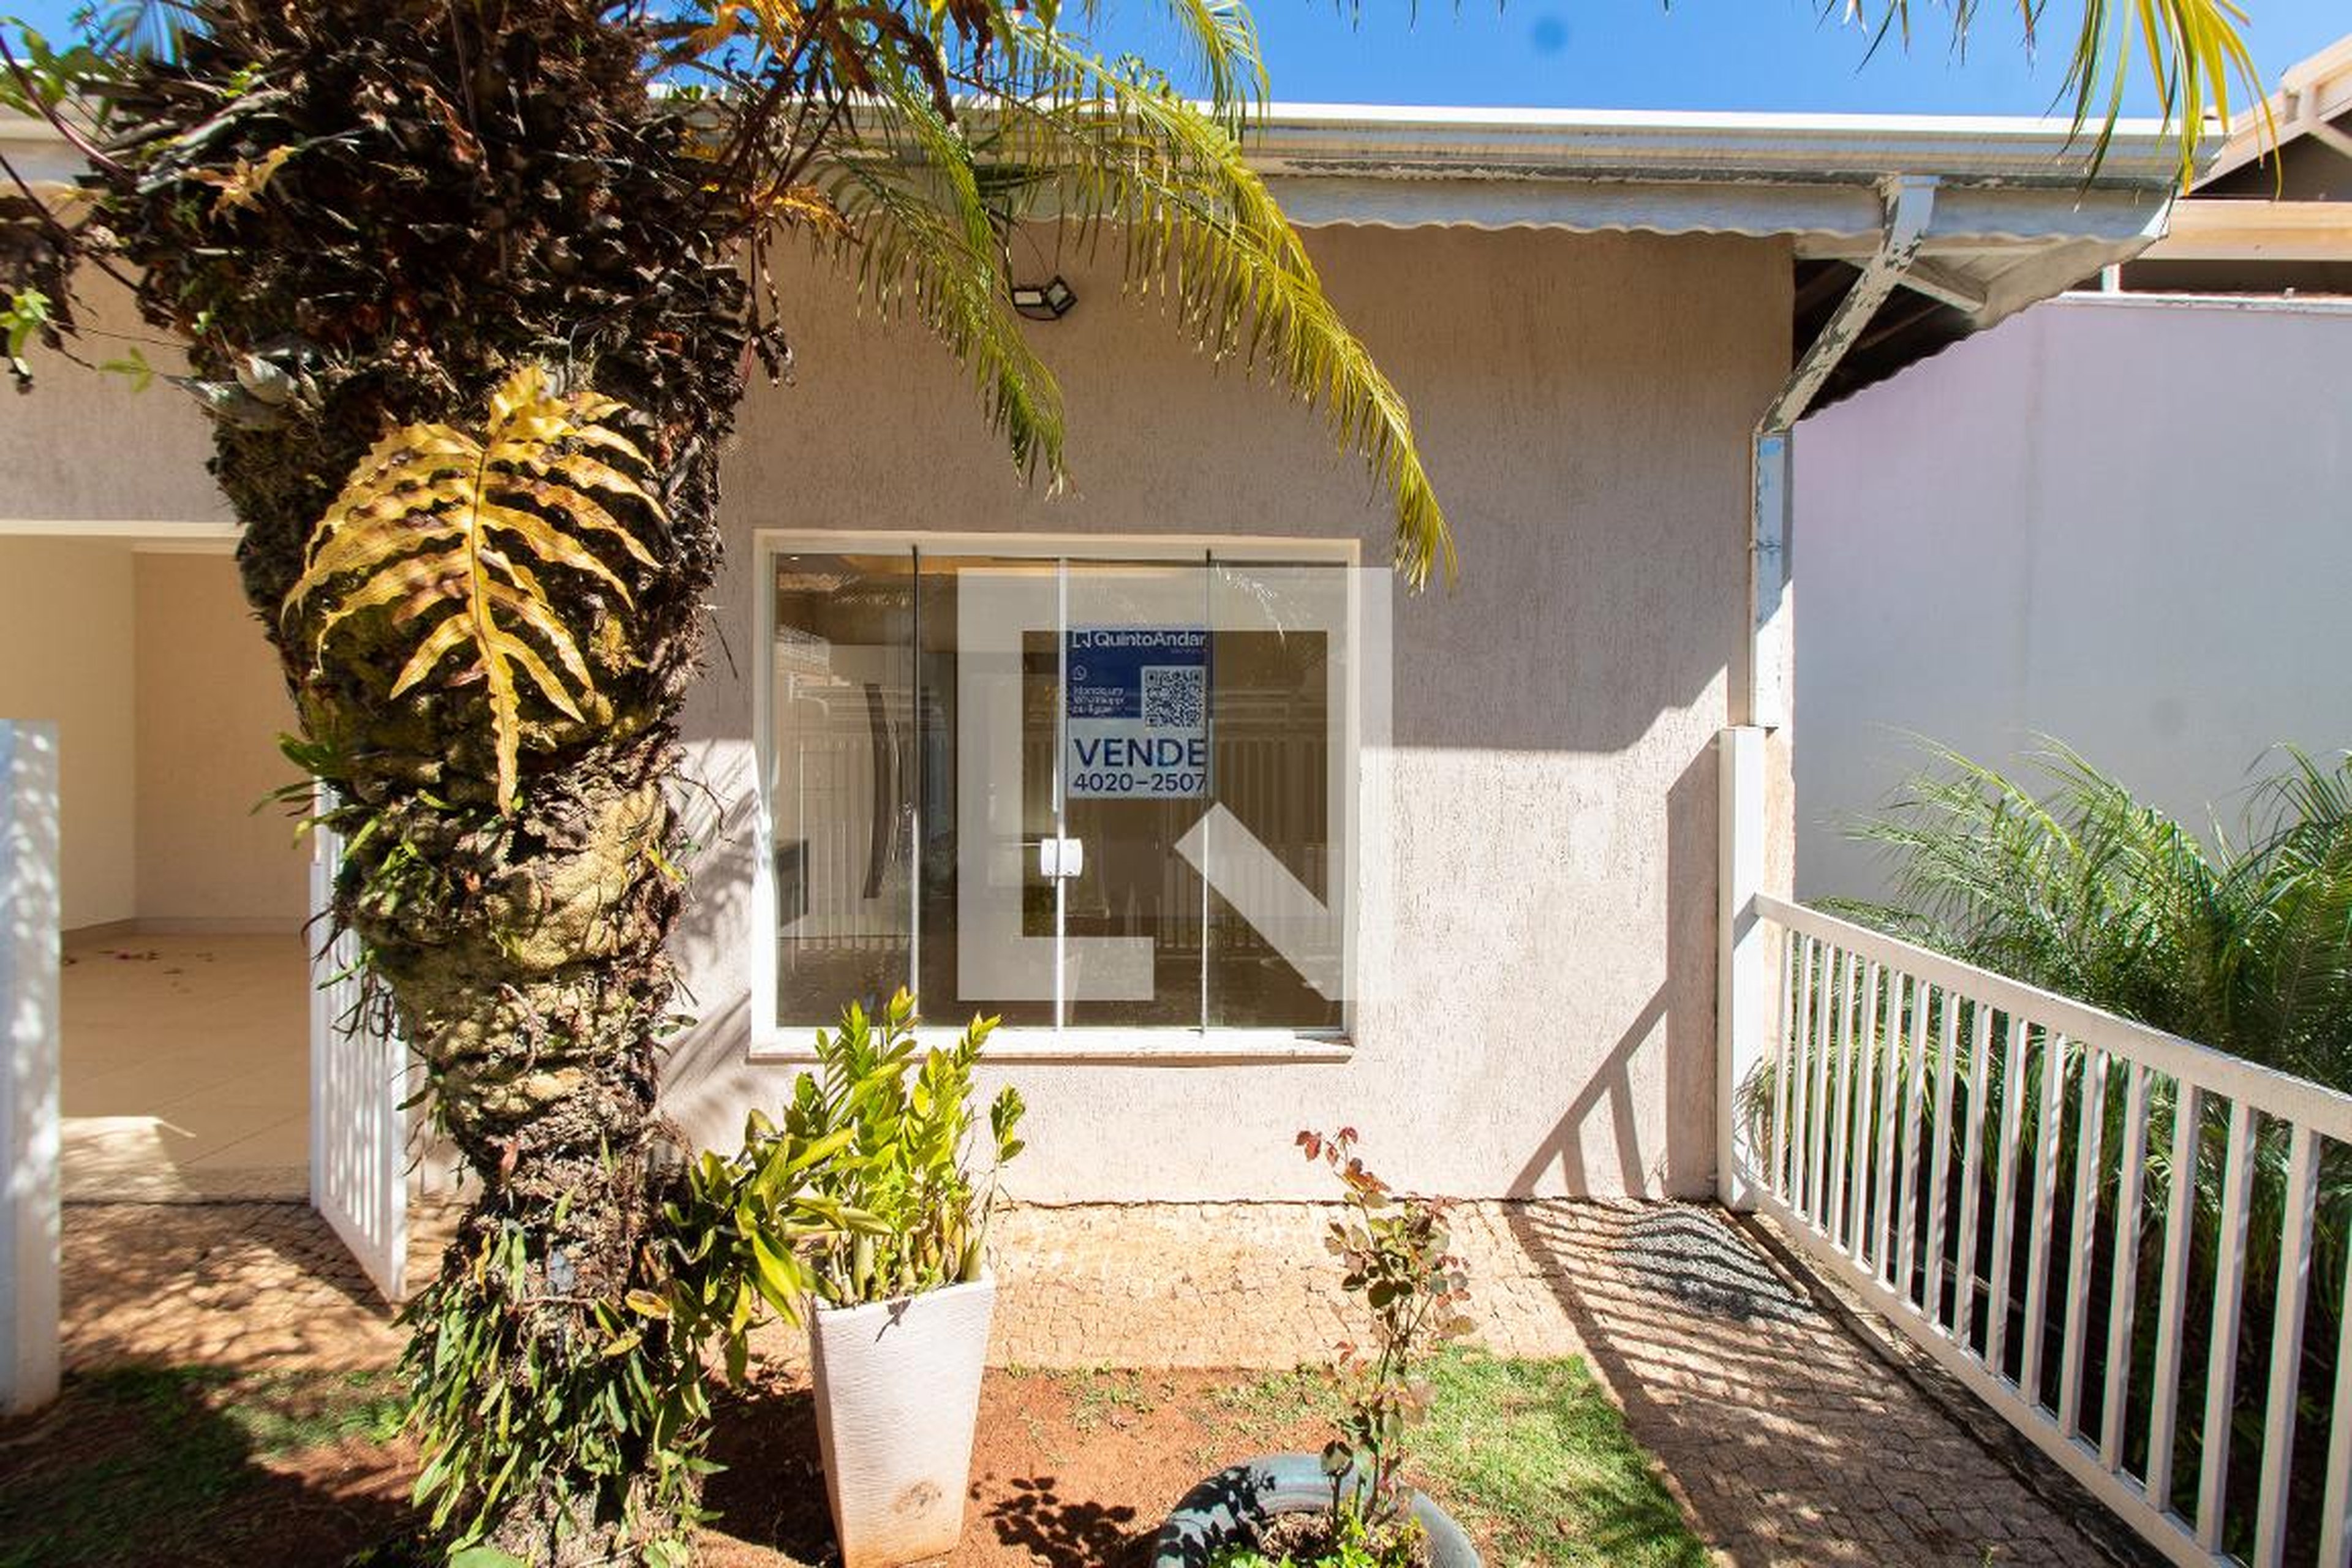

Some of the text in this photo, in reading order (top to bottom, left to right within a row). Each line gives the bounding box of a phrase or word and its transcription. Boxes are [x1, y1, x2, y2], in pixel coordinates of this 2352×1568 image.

[1095, 632, 1207, 647] QuintoAndar
[1074, 738, 1207, 767] VENDE
[1074, 773, 1206, 791] 4020-2507
